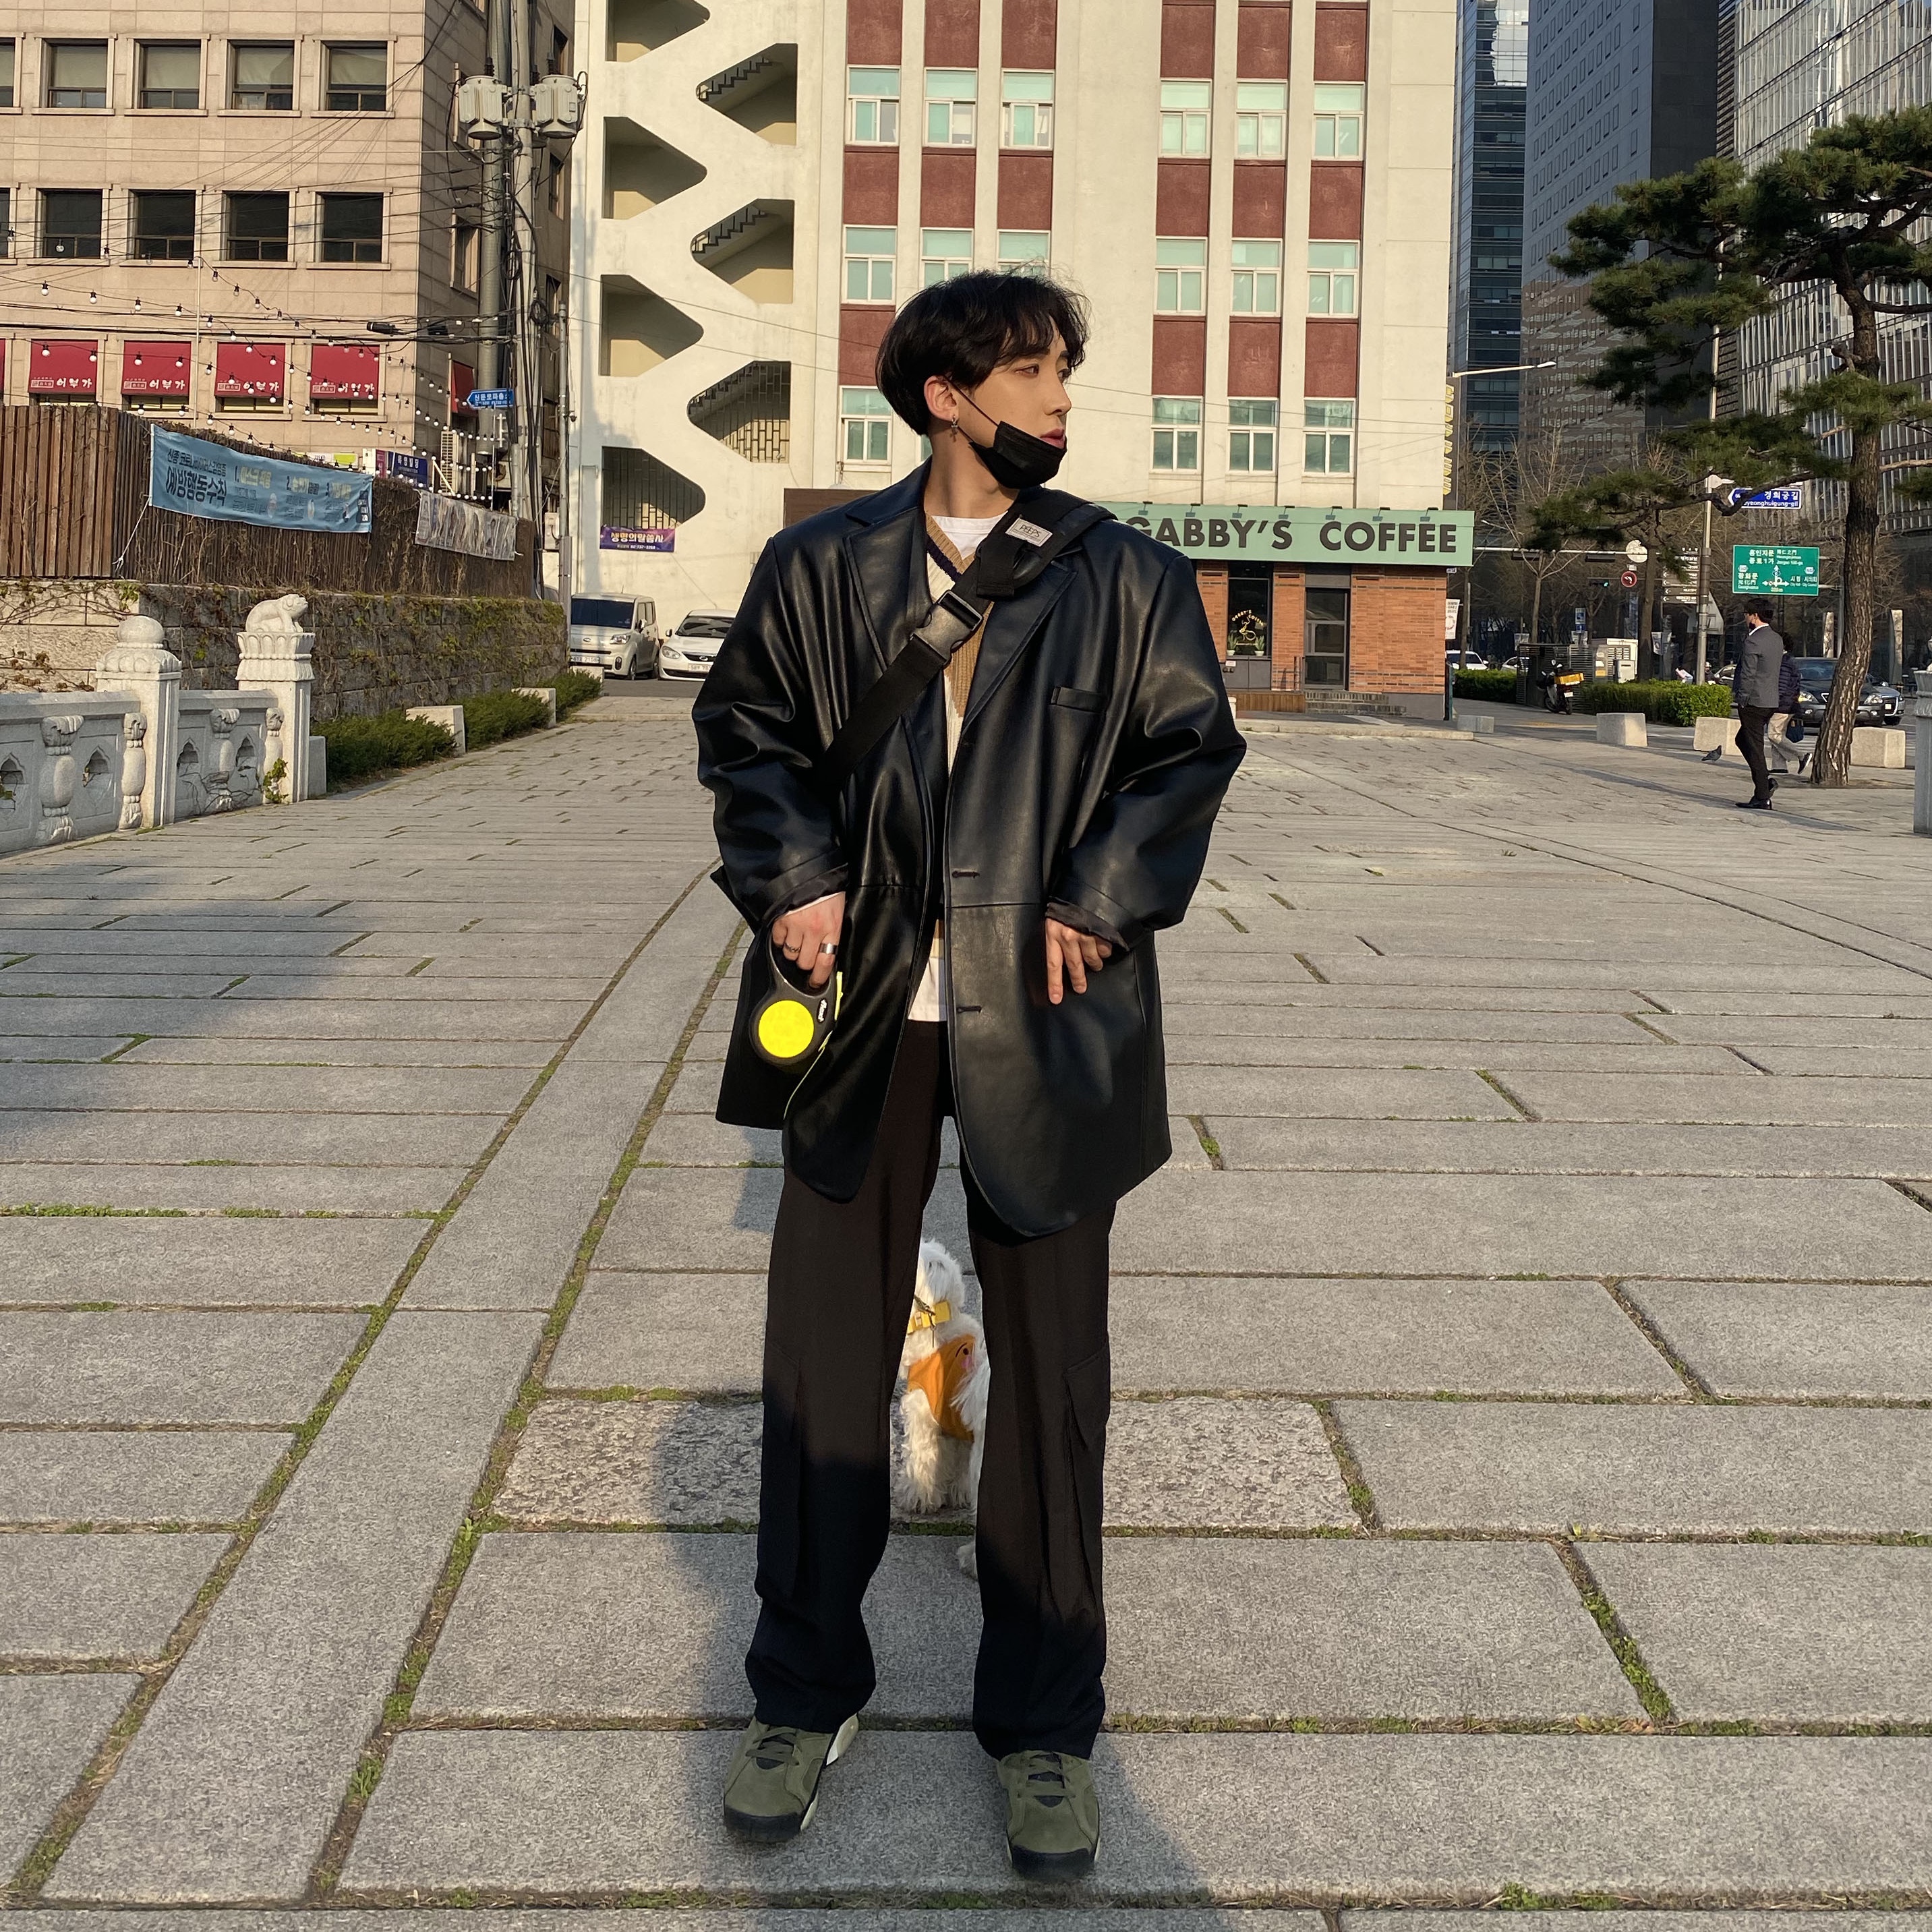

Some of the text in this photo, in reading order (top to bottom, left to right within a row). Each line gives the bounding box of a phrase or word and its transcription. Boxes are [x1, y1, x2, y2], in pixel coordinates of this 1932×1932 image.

[57, 378, 92, 388] 어부가
[149, 379, 185, 390] 어부가
[165, 466, 227, 506] 예방행동수칙
[1764, 491, 1798, 500] 경희궁길
[611, 532, 664, 543] 생명의말씀사
[1319, 521, 1457, 554] COFFEE
